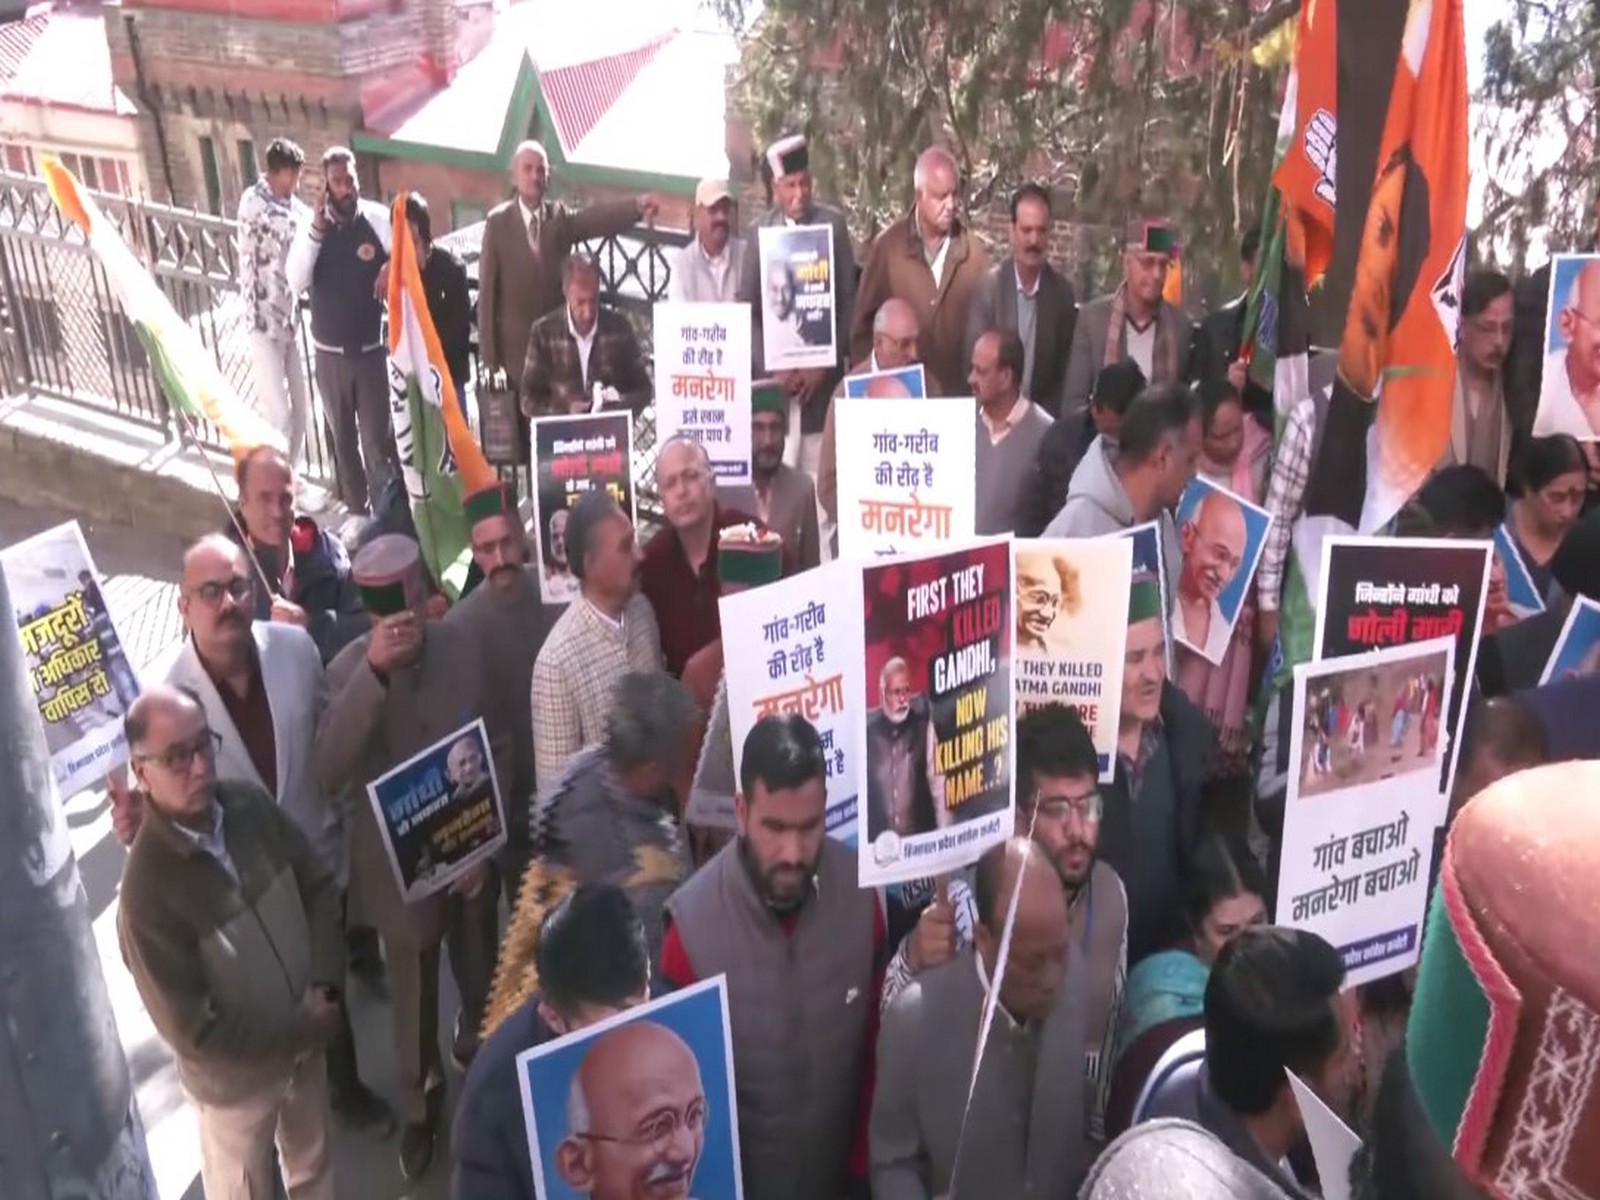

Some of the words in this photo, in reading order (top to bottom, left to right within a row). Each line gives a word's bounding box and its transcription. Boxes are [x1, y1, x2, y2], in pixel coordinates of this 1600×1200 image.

[683, 348, 695, 365] की
[717, 348, 723, 365] है
[671, 370, 736, 402] मनरेगा
[706, 428, 722, 442] पाप
[725, 425, 732, 442] है
[873, 427, 939, 454] गांव-गरीब
[874, 461, 893, 487] की
[923, 462, 934, 487] है
[858, 493, 953, 539] मनरेगा
[907, 576, 948, 622] FIRST
[952, 563, 985, 605] THEY
[1407, 582, 1440, 605] गांधी
[1442, 584, 1460, 605] को
[762, 600, 826, 644] गांव-गरीब
[954, 595, 1000, 646] KILLED
[1347, 607, 1409, 645] गोली
[38, 638, 102, 687] अधिकार
[767, 651, 787, 679] की
[791, 642, 813, 674] रीढ़
[814, 636, 825, 663] है
[934, 639, 996, 694] GANDHI,
[1023, 660, 1055, 677] THEY
[1059, 661, 1103, 678] KILLED
[38, 684, 92, 723] वापिस
[88, 669, 112, 697] दो
[956, 685, 987, 727] NOW
[1052, 681, 1102, 697] GANDHI
[834, 748, 845, 775] है
[934, 727, 983, 773] KILLING
[987, 715, 1008, 750] HIS
[1313, 834, 1348, 871] गांव
[1351, 810, 1410, 859] बचाओ
[1292, 875, 1361, 921] मनरेगा
[1364, 847, 1421, 897] बचाओ
